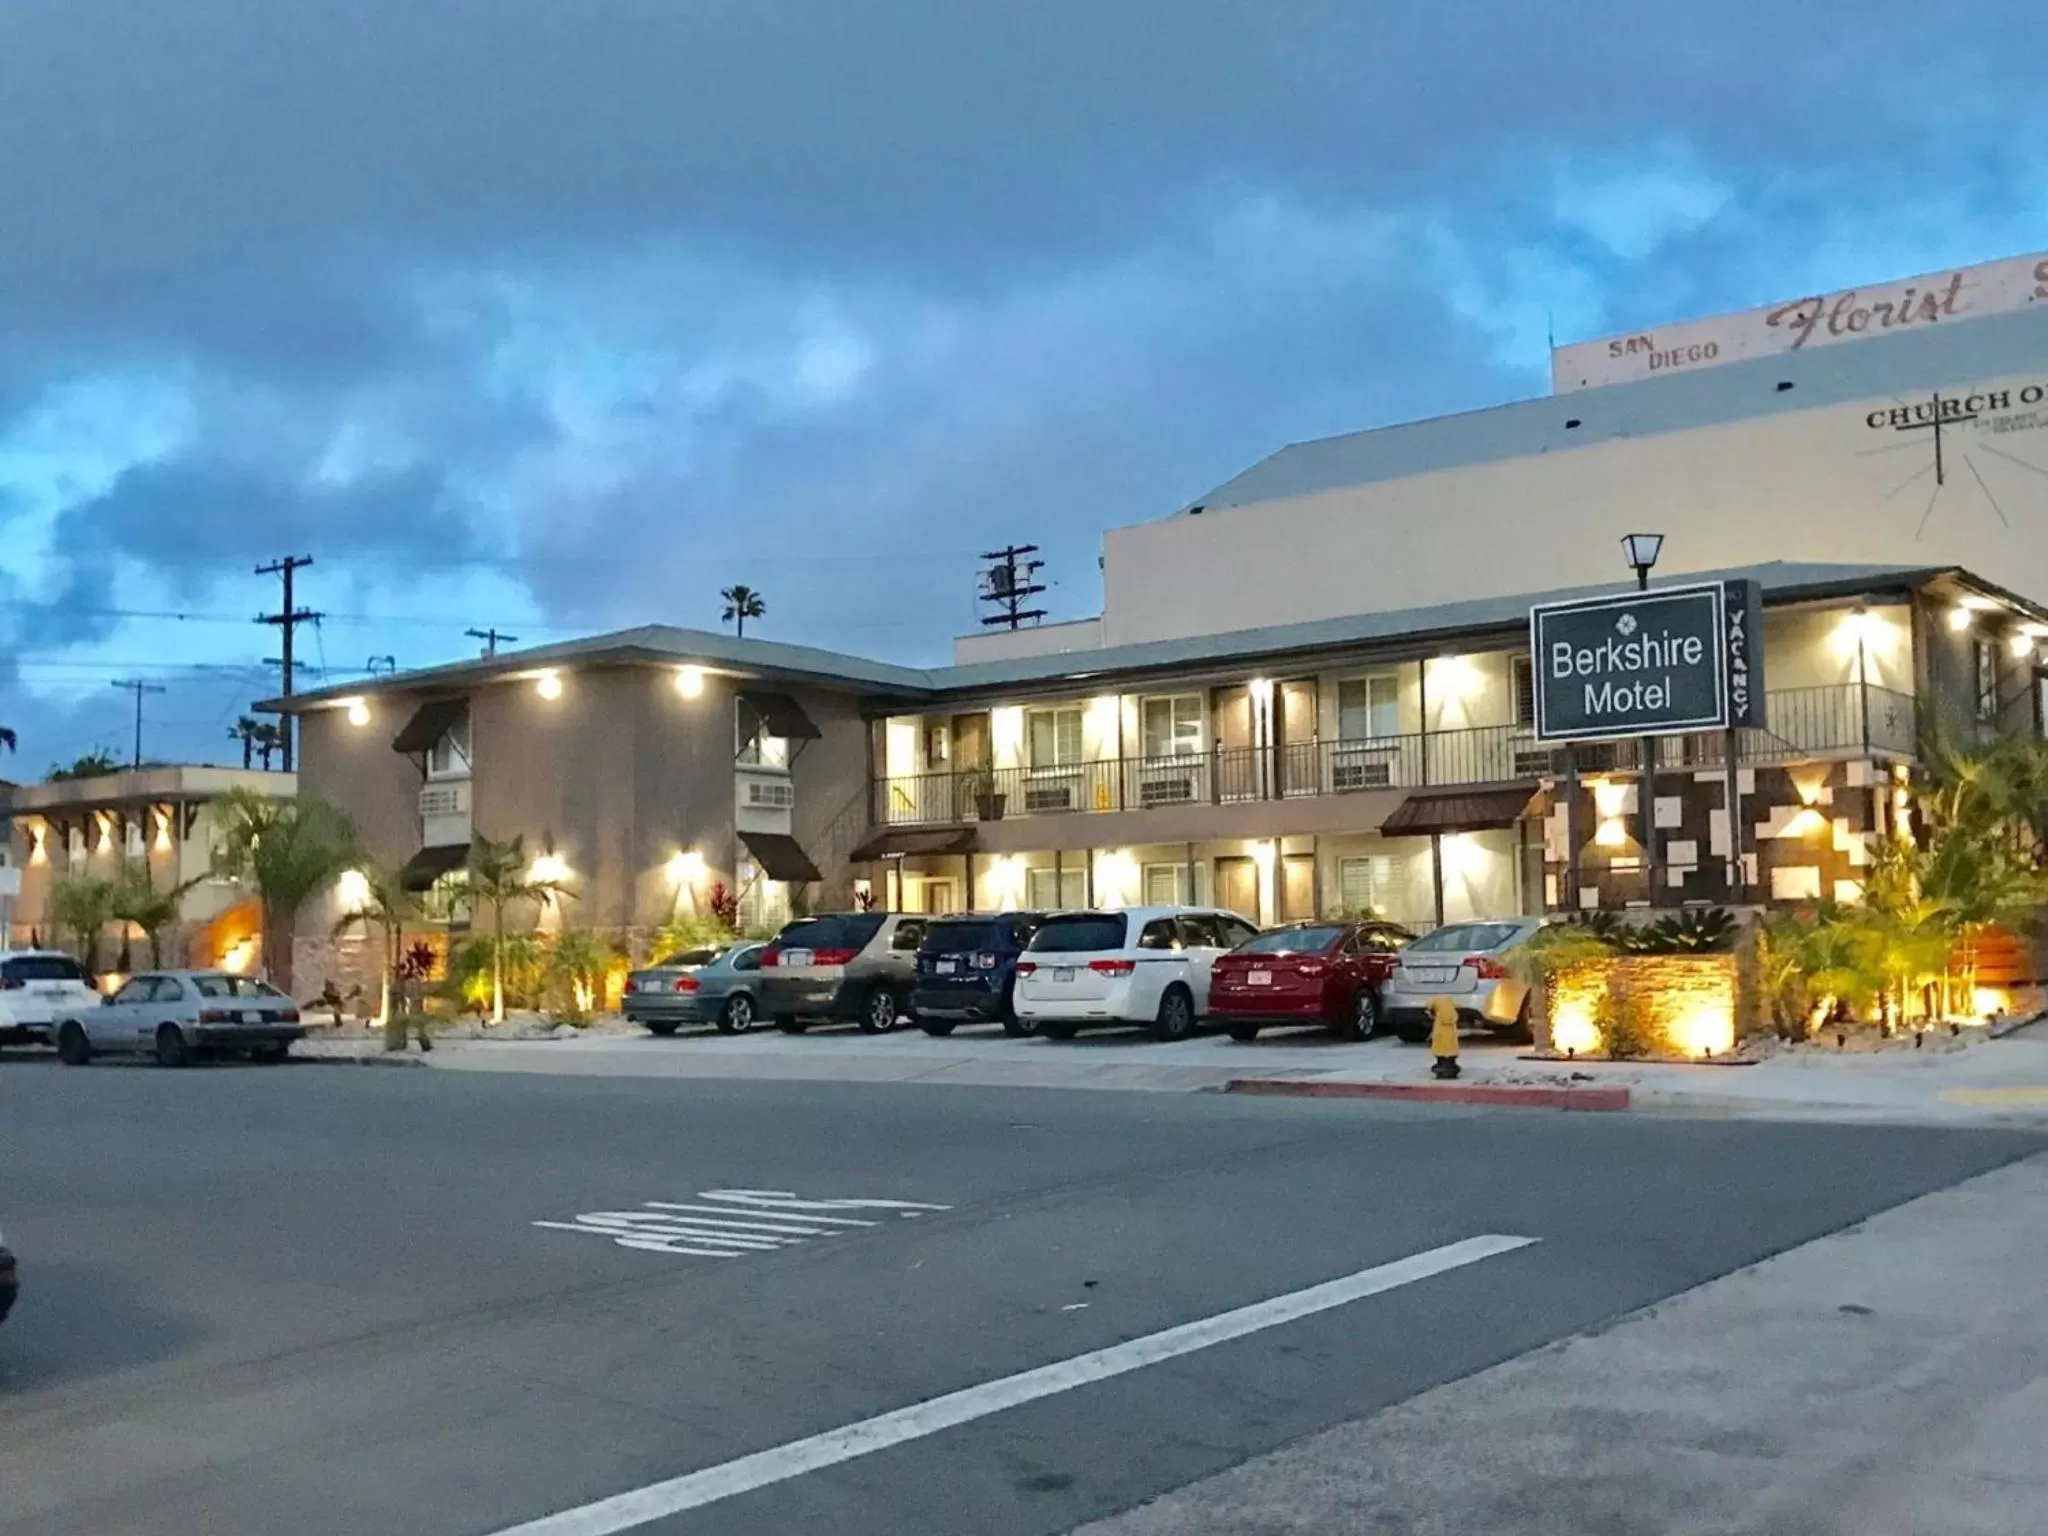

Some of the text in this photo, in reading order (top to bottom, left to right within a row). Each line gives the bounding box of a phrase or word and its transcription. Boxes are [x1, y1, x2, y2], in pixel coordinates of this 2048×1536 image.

[1766, 272, 1965, 350] Florist
[1609, 334, 1653, 358] SAN
[1649, 341, 1718, 370] DIEGO
[1866, 389, 2011, 428] CHURCH
[2020, 384, 2048, 404] O
[1552, 629, 1703, 678] Berkshire
[1728, 608, 1749, 718] VACANCY
[1584, 675, 1671, 715] Motel
